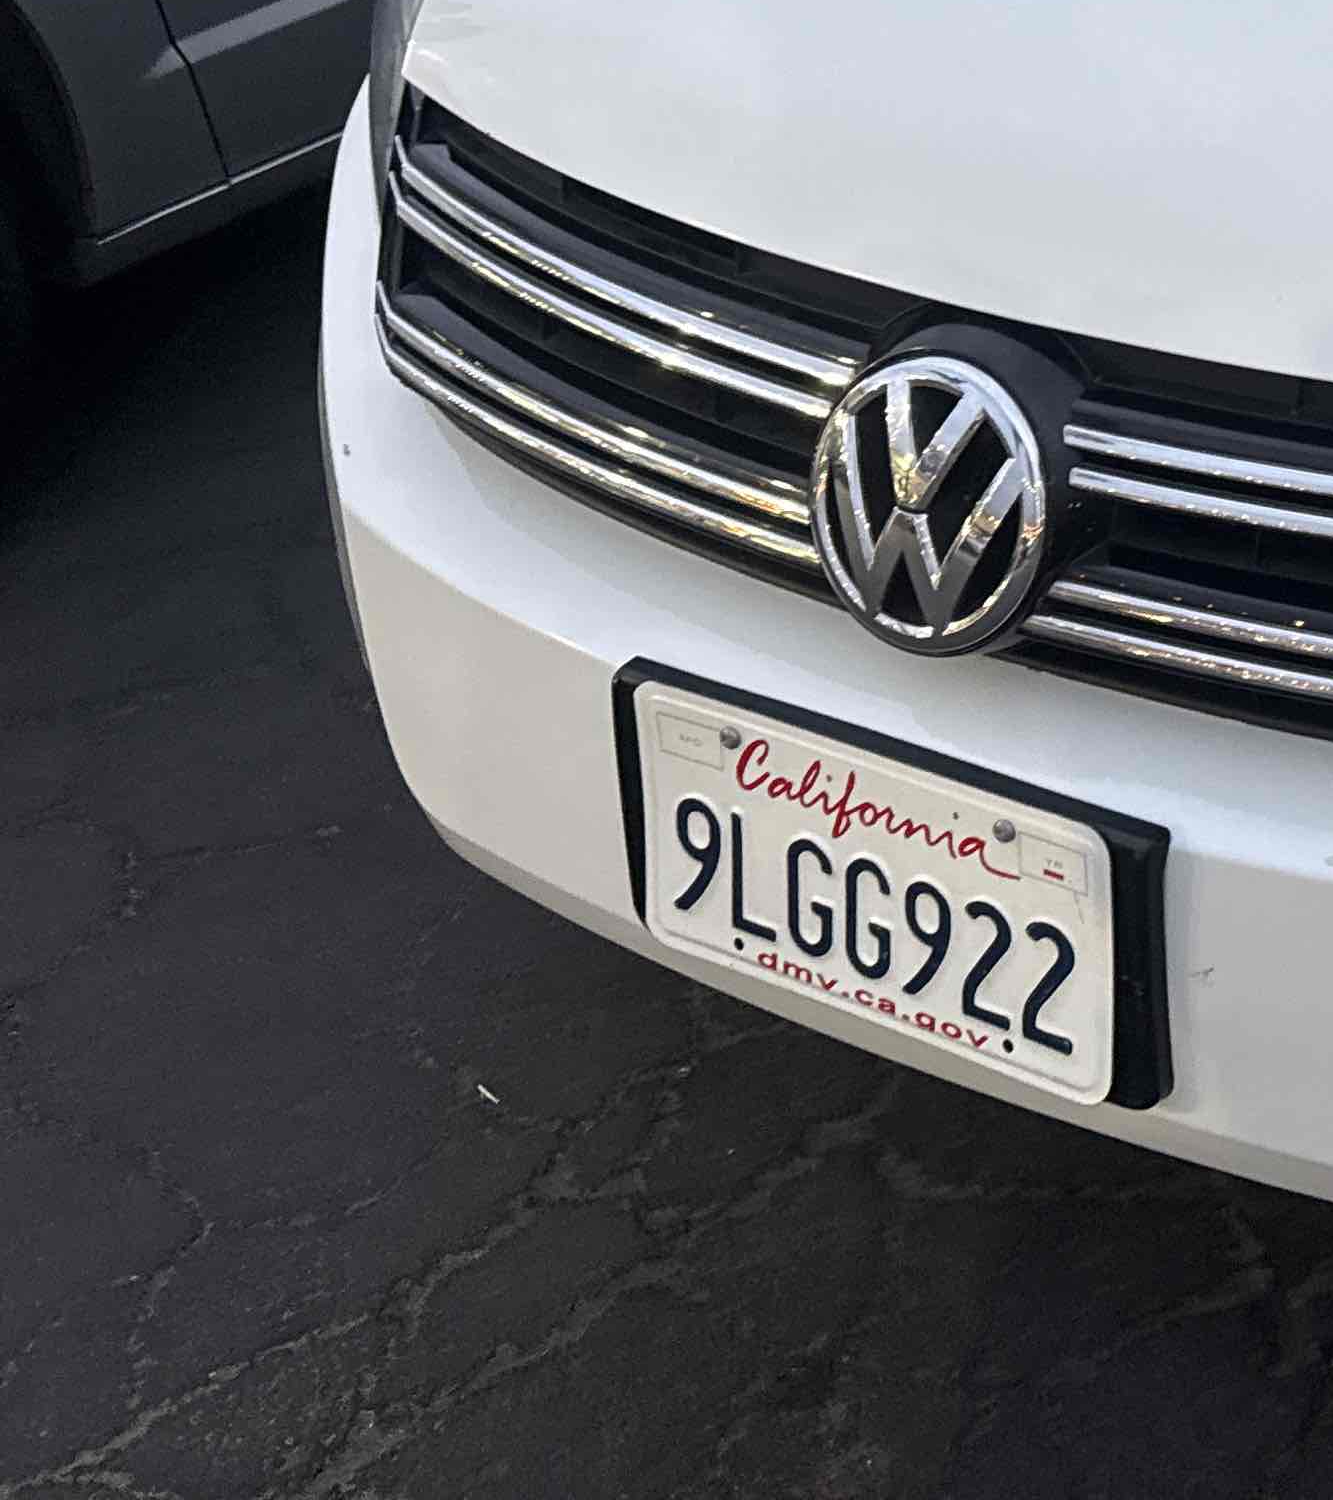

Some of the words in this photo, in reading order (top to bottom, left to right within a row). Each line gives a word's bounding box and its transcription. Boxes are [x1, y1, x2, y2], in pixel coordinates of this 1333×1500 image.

[734, 738, 1022, 881] California
[673, 796, 1076, 1056] 9LGG922
[756, 948, 991, 1049] dmv.ca.gov
